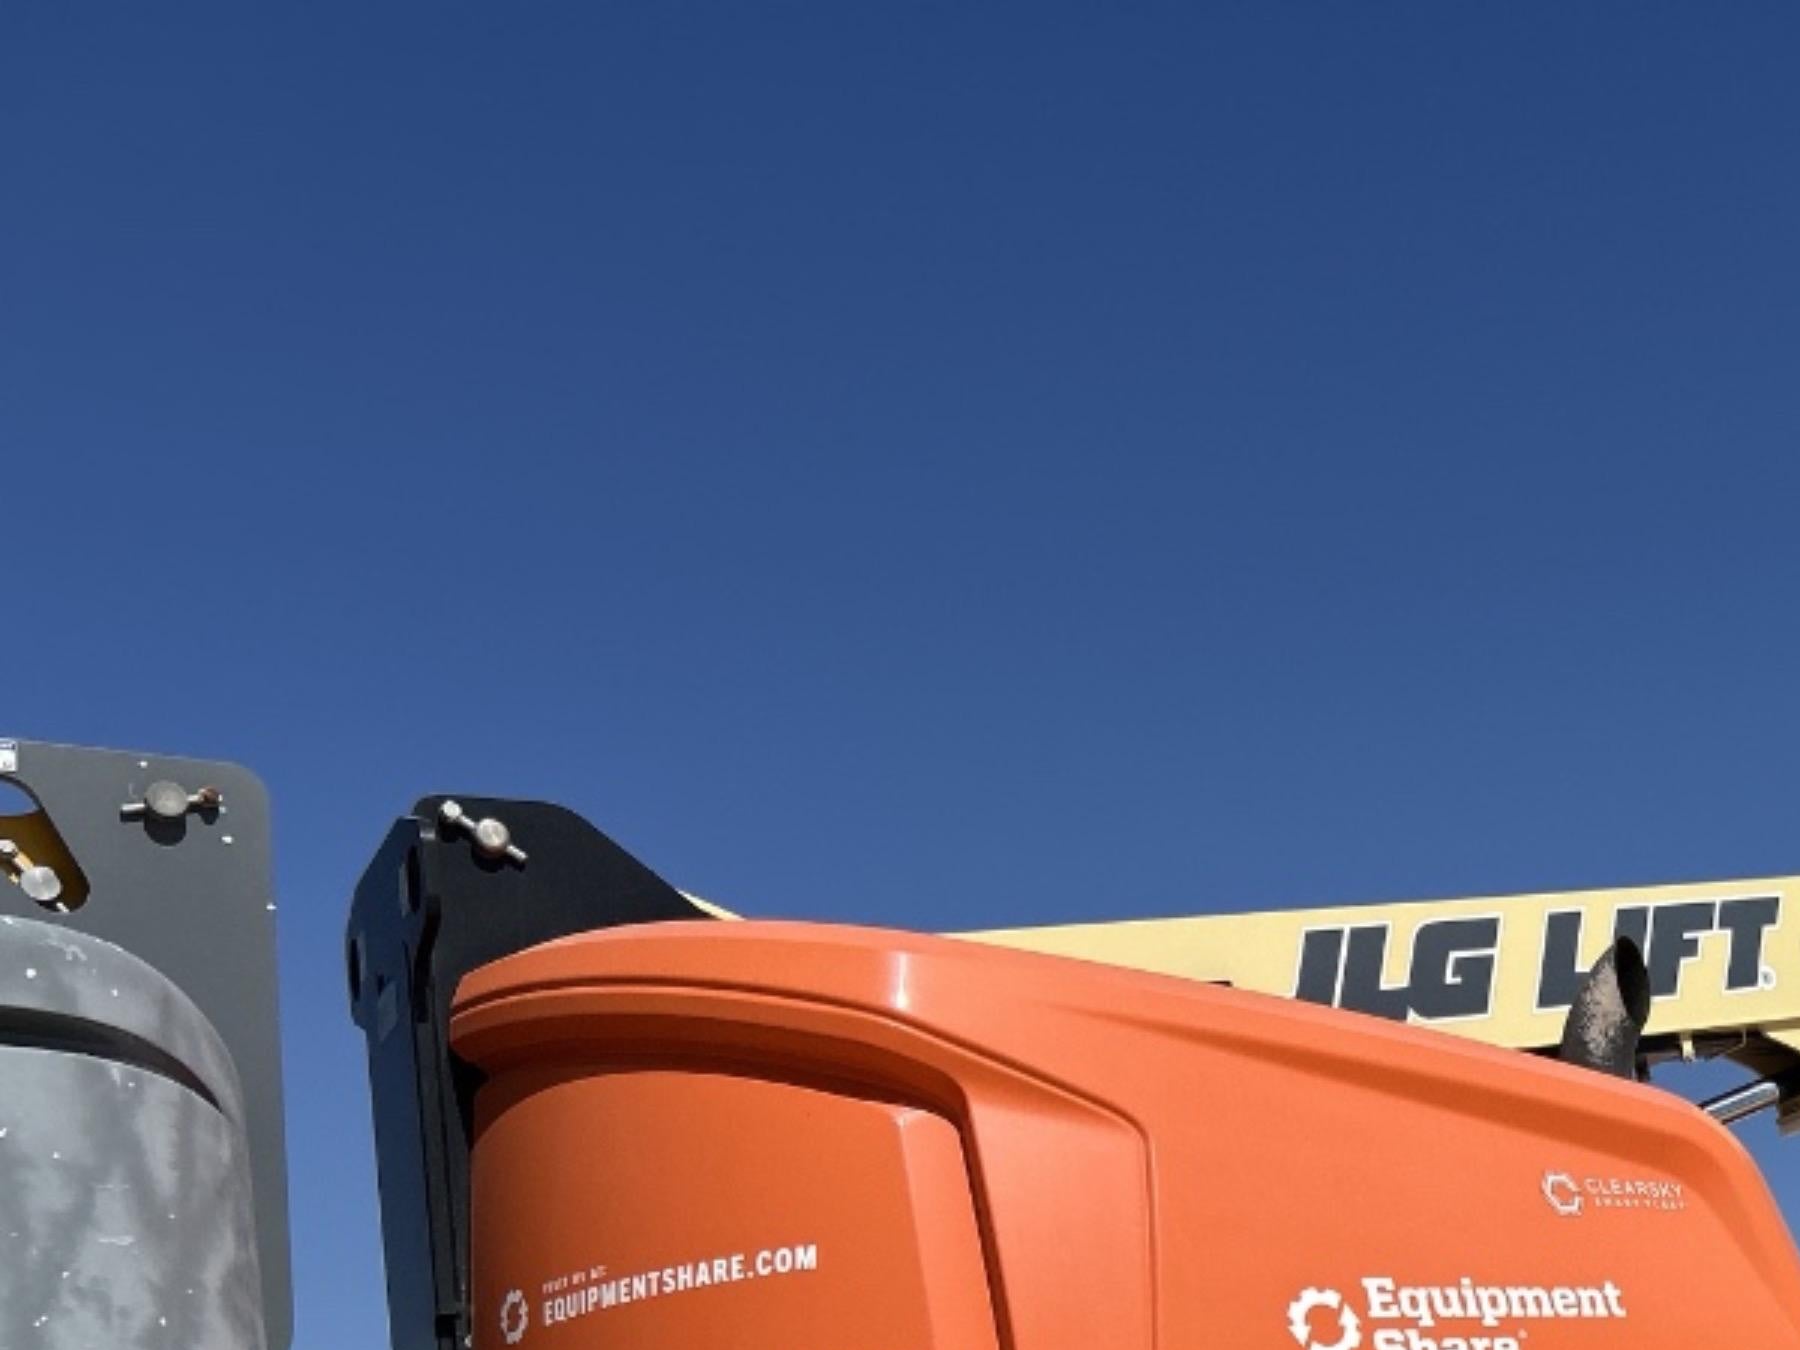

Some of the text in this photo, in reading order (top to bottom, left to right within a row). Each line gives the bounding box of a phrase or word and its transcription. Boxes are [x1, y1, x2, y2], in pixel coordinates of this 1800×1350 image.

[1534, 893, 1782, 1012] LIFT
[543, 1244, 818, 1327] EQUIPMENTSHARE.COM
[1360, 1276, 1627, 1327] Equipment
